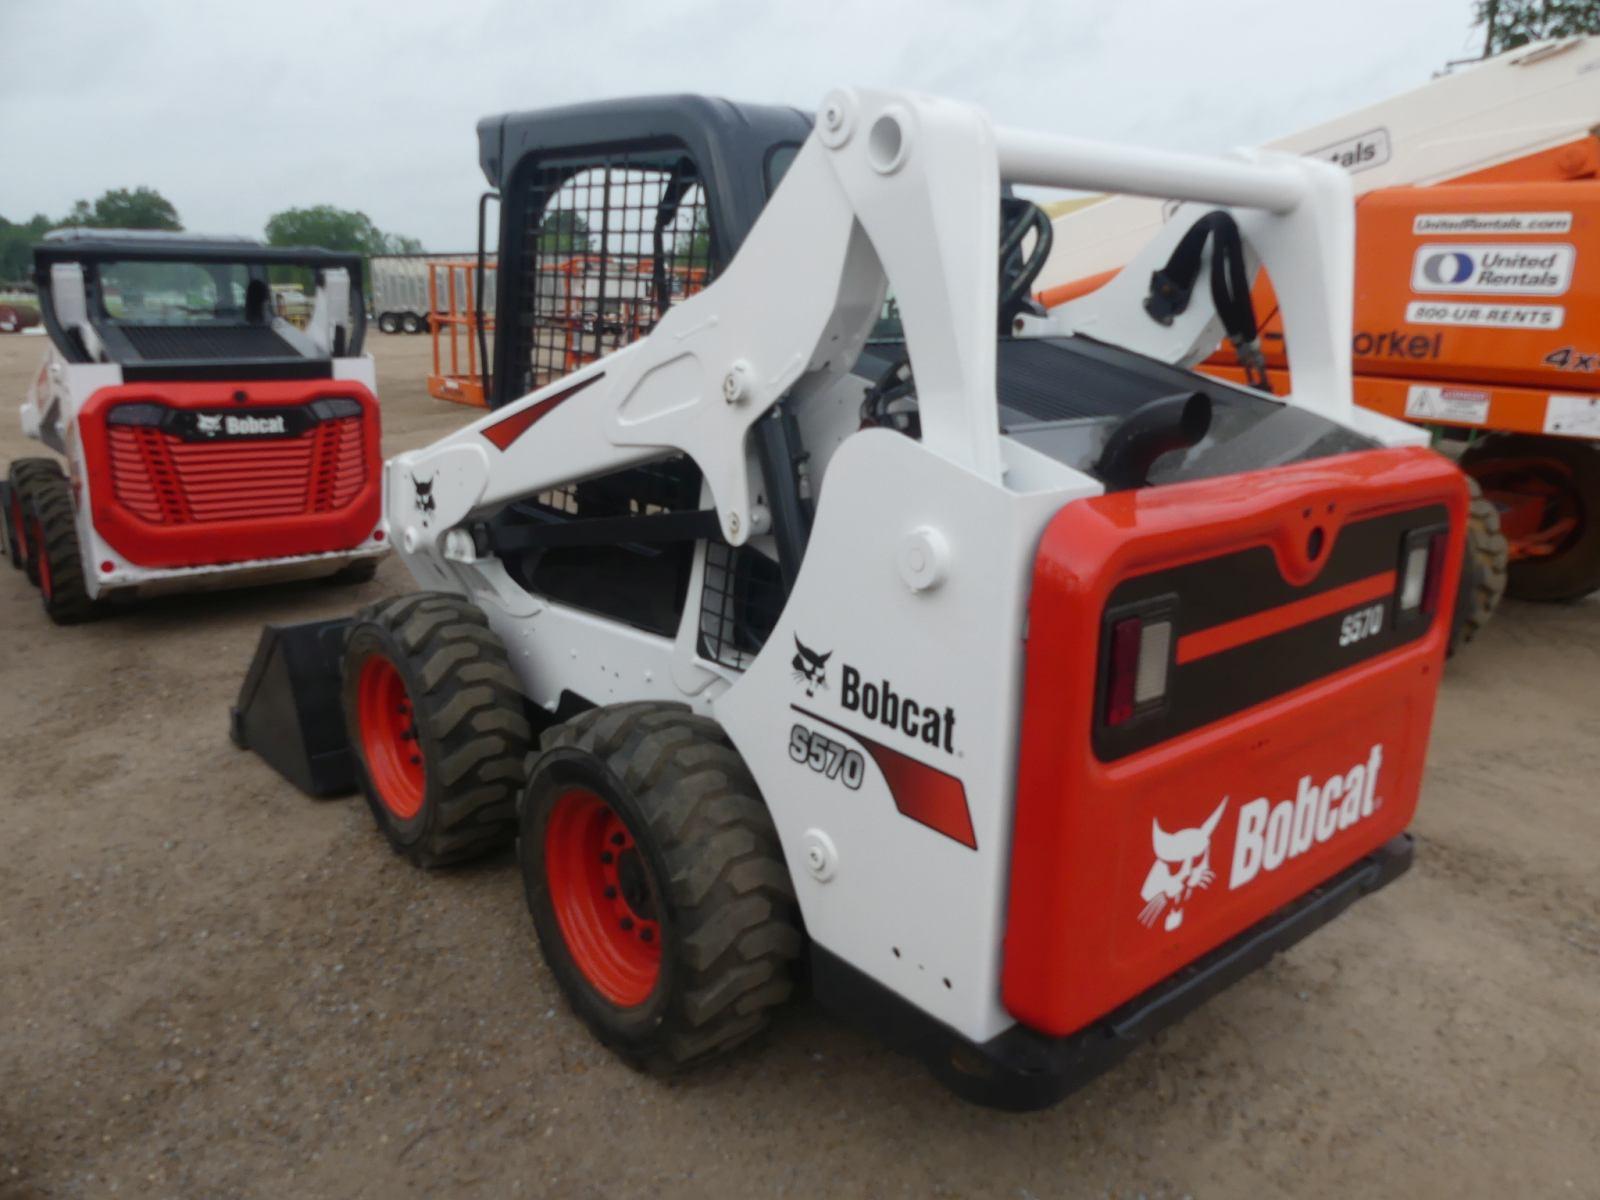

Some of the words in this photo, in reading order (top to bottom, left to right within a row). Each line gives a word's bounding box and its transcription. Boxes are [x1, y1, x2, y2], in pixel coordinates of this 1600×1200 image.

[1481, 252, 1558, 268] United
[1477, 271, 1559, 287] Rentals
[1353, 329, 1443, 358] orkel
[1543, 347, 1600, 371] 4x
[225, 414, 286, 435] Bobcat
[1339, 604, 1384, 647] S570
[840, 663, 956, 755] Bobcat
[788, 723, 865, 791] S570
[1228, 743, 1383, 890] Bobcat
